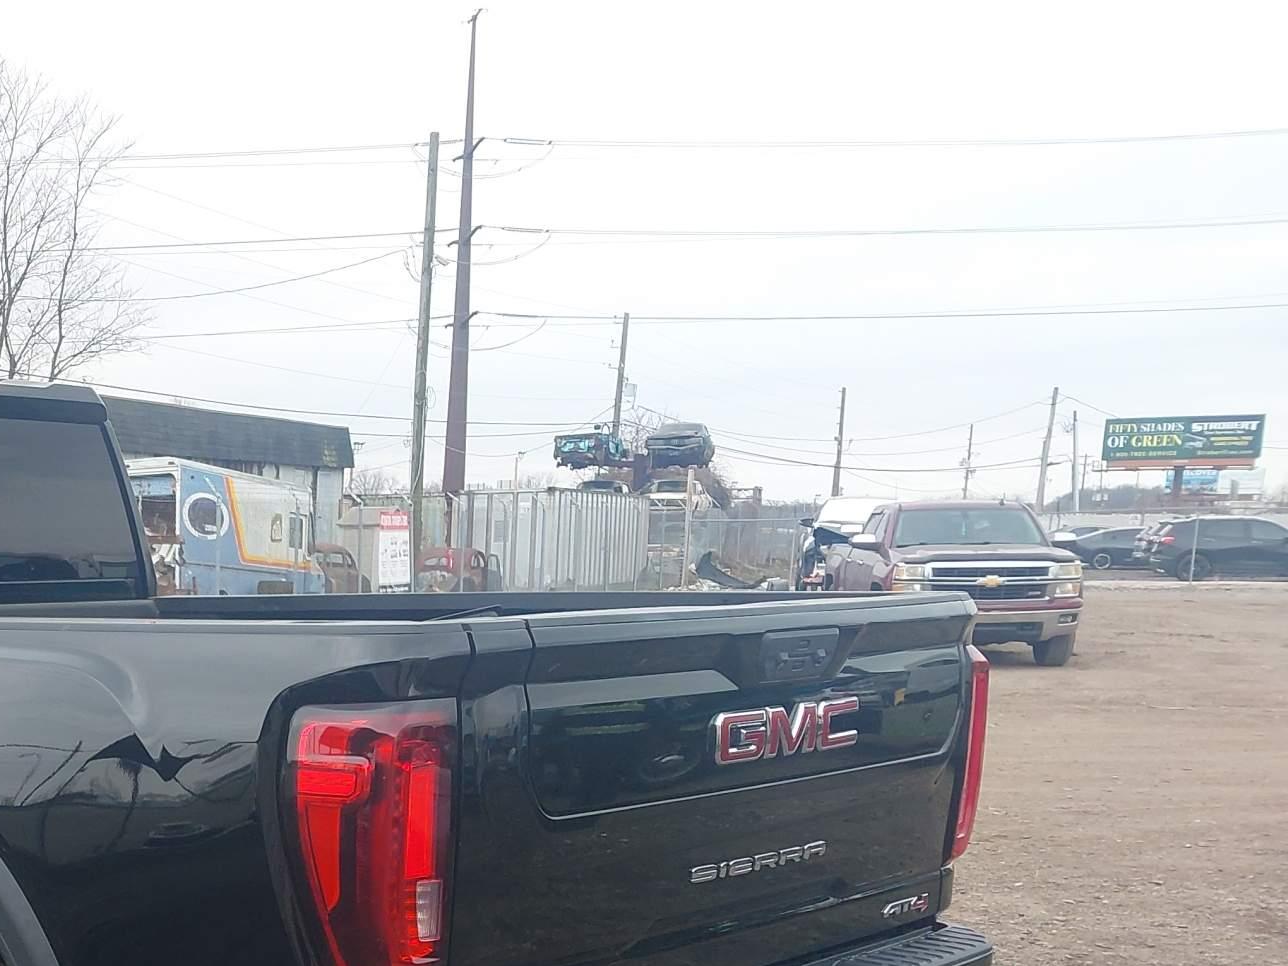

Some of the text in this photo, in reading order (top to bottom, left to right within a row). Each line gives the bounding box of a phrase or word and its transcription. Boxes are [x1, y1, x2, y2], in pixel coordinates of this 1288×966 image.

[1107, 434, 1182, 448] OF GREEN
[1109, 422, 1185, 433] FIFTY SHADES
[713, 695, 862, 766] GMC
[688, 839, 829, 885] SIERRA
[880, 892, 930, 919] AT4
